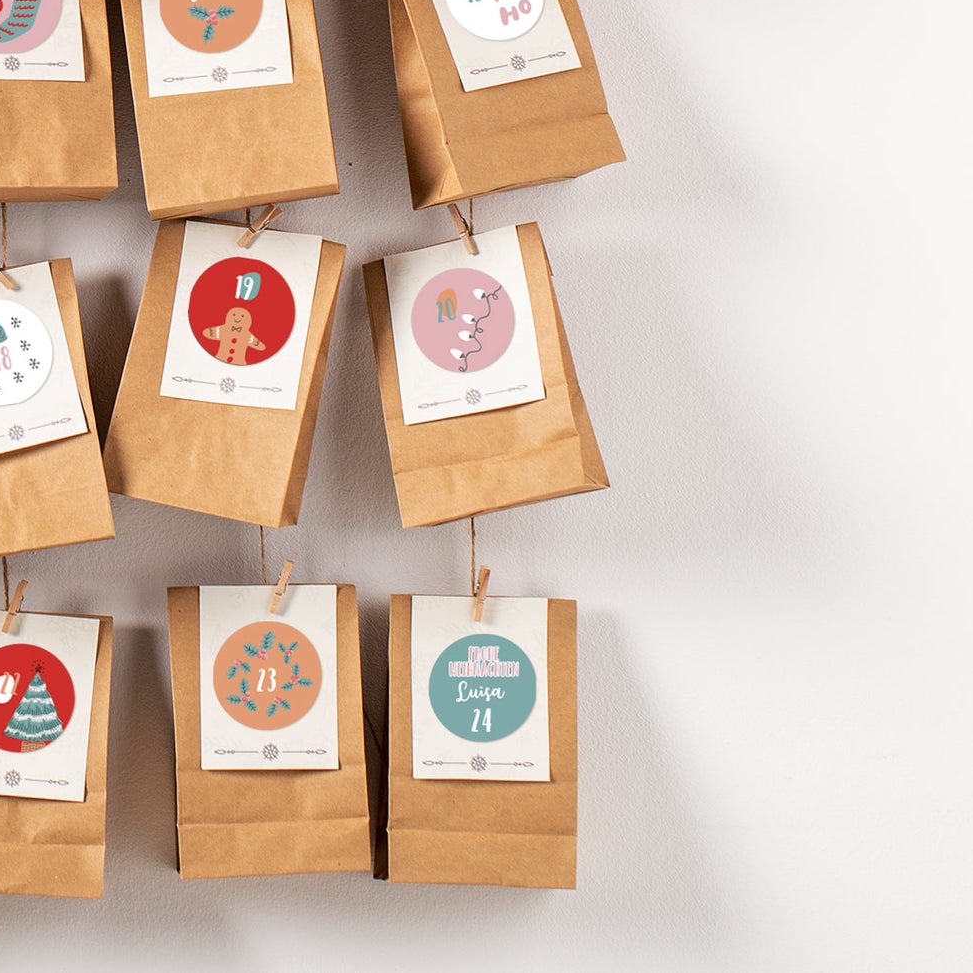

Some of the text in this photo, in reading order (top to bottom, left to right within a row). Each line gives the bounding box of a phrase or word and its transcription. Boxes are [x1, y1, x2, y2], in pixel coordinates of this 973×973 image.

[235, 275, 253, 299] 19
[437, 298, 456, 323] 20
[468, 646, 499, 662] FROHE
[257, 667, 276, 692] 23
[448, 660, 520, 677] WEIHNACHTEN
[456, 681, 505, 703] Luisa
[471, 708, 491, 732] 24
